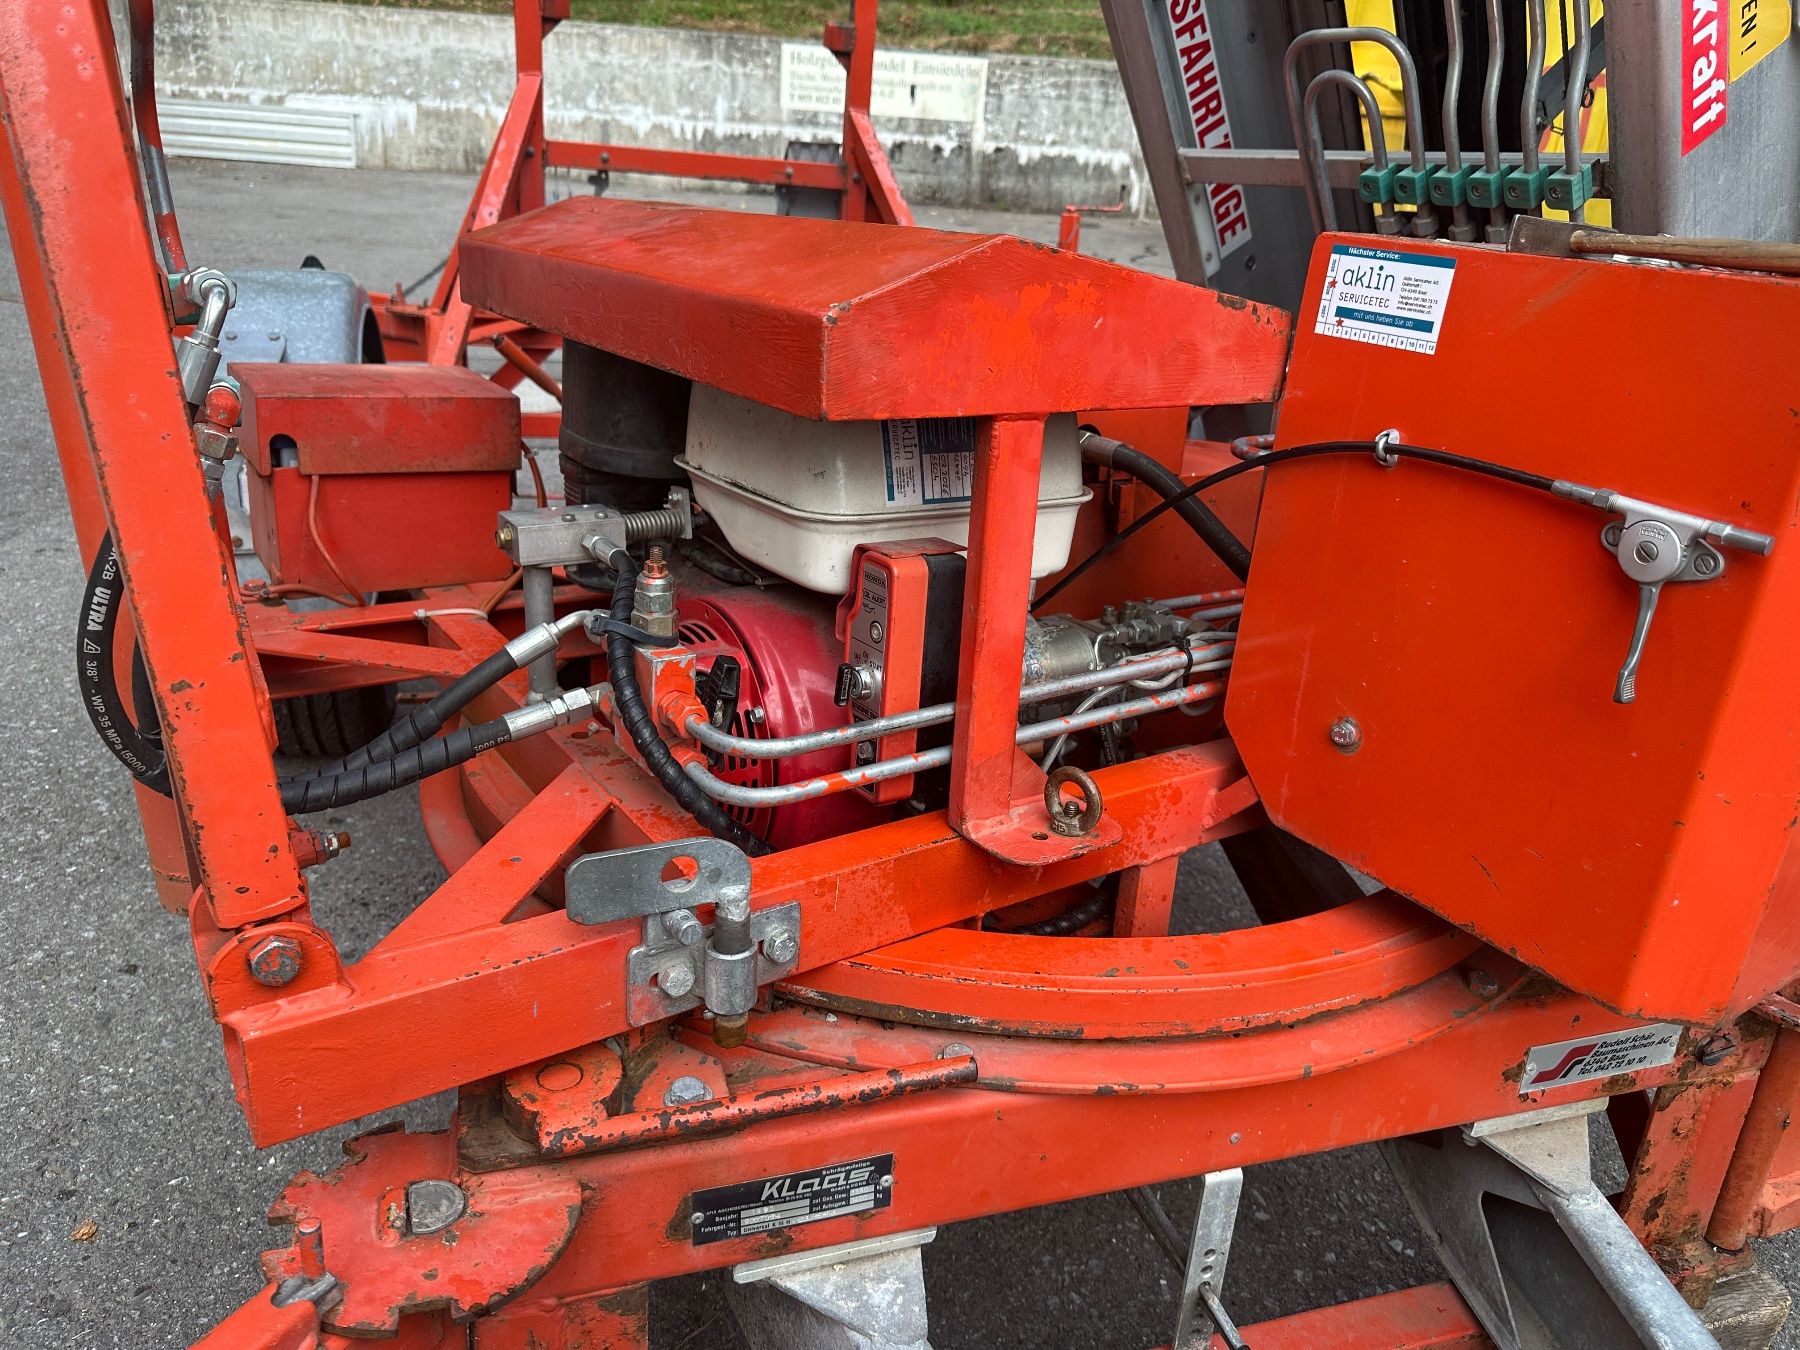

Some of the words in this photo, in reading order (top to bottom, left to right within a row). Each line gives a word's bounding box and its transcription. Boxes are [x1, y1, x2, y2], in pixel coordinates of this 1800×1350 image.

[1349, 247, 1375, 257] Nächster
[1376, 250, 1401, 260] Service:
[1342, 265, 1395, 292] aklin
[1339, 291, 1390, 308] SERVICETEC
[1353, 311, 1363, 319] mit
[1376, 315, 1392, 324] heben
[1395, 318, 1404, 326] Sie
[87, 586, 111, 631] ULTRA
[91, 695, 105, 714] WP
[98, 715, 111, 728] 35
[105, 728, 122, 750] MPa
[1590, 1040, 1656, 1059] Baumaschinen
[1655, 1035, 1673, 1046] AG
[1597, 1036, 1631, 1050] Rudolf
[1629, 1031, 1656, 1044] Schär
[1578, 1066, 1592, 1076] Tel.
[1594, 1062, 1610, 1073] 042
[1611, 1059, 1623, 1069] 32
[1625, 1056, 1636, 1066] 10
[1636, 1055, 1647, 1064] 10
[1583, 1056, 1608, 1068] 6340
[1607, 1053, 1630, 1063] Baar
[743, 1223, 769, 1233] Universal
